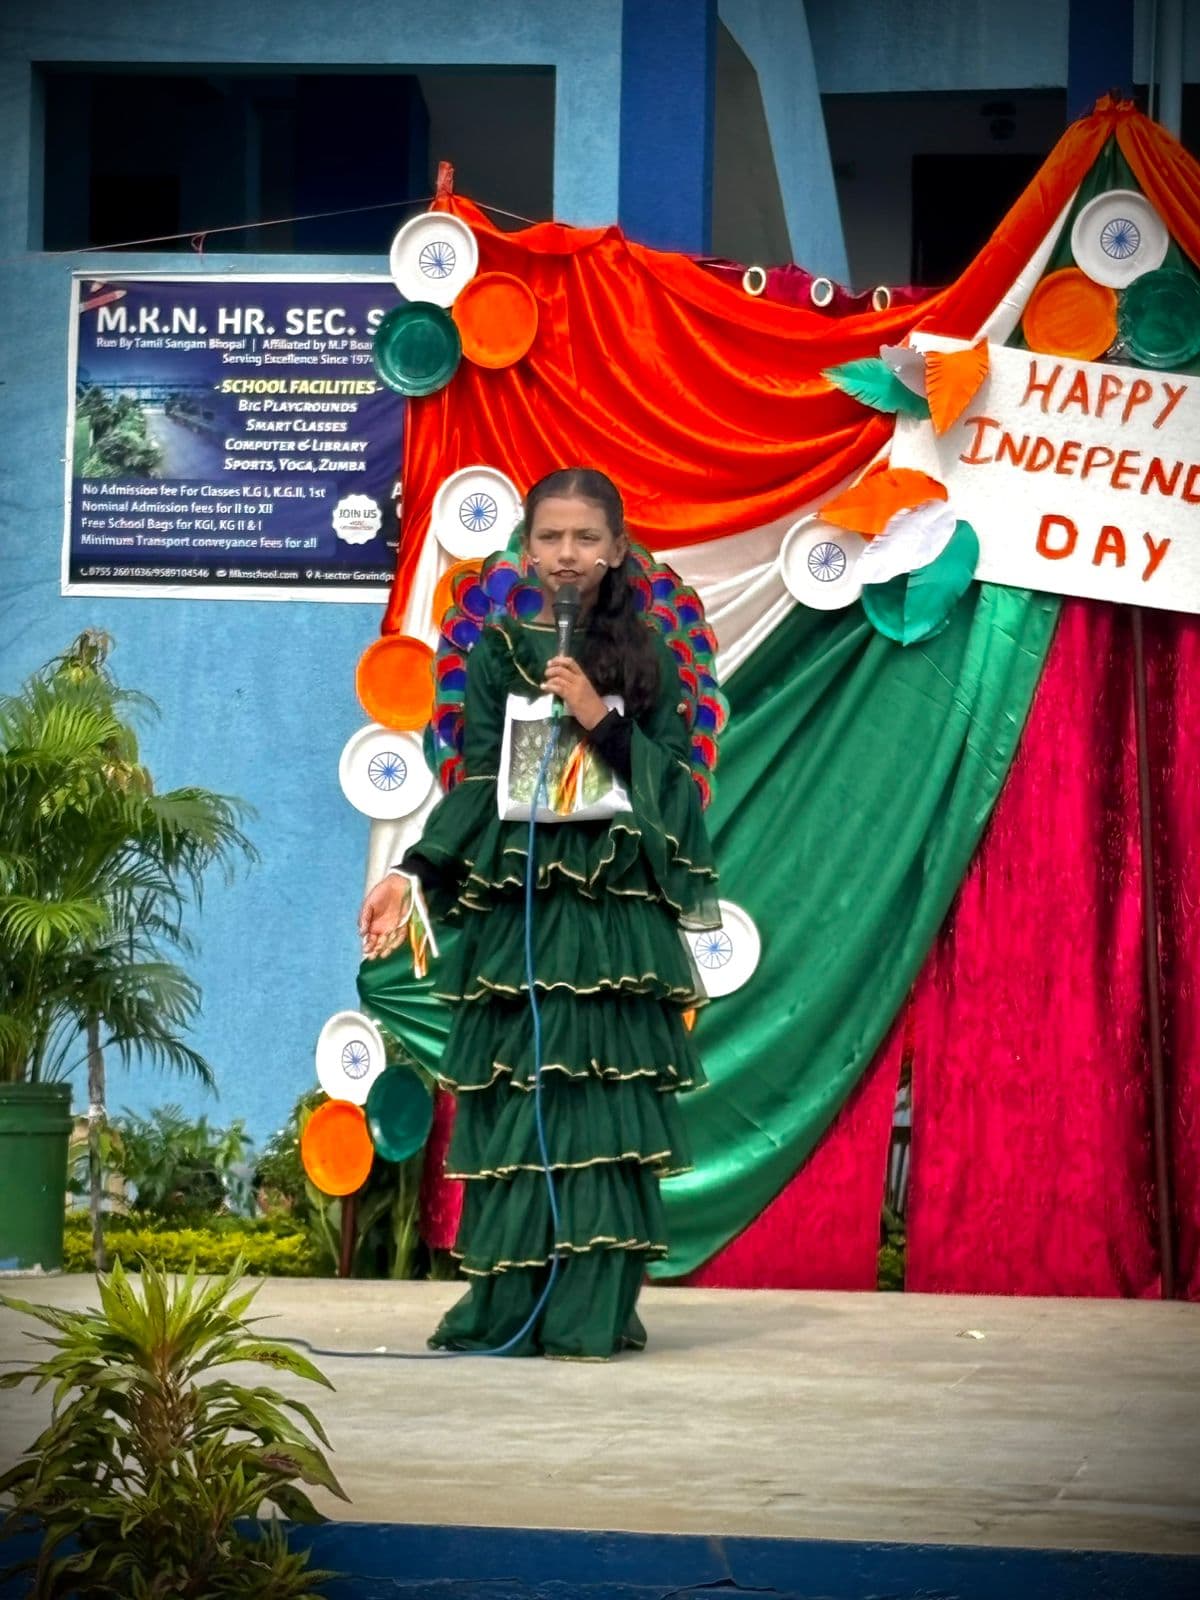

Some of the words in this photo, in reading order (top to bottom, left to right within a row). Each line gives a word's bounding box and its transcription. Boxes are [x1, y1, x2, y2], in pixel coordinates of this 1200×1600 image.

[97, 306, 207, 334] M.K.N.
[218, 308, 275, 335] HR.
[285, 308, 356, 335] SEC.
[96, 337, 117, 348] Run
[134, 338, 163, 349] Tamil
[165, 339, 206, 351] Sangam
[208, 339, 246, 351] Bhopal
[262, 340, 311, 350] Affiliated
[350, 341, 374, 350] Boar
[222, 353, 262, 366] Serving
[264, 354, 318, 365] Excellence
[320, 355, 349, 365] Since
[1019, 359, 1188, 430] HAPPY
[100, 484, 159, 496] Admission
[160, 485, 178, 496] fee
[180, 486, 199, 496] For
[200, 486, 241, 497] Classes
[81, 501, 129, 512] Nominal
[130, 502, 189, 513] Admission
[191, 502, 214, 513] fees
[216, 503, 233, 513] for
[257, 503, 274, 514] XII
[338, 509, 361, 519] JOIN
[81, 518, 106, 528] Free
[108, 518, 145, 529] School
[147, 519, 174, 532] Bags
[176, 519, 193, 530] for
[81, 535, 135, 546] Minimum
[136, 535, 190, 548] Transport
[260, 537, 284, 548] fees
[285, 537, 302, 548] for
[303, 538, 317, 548] all
[1035, 513, 1172, 582] DAY
